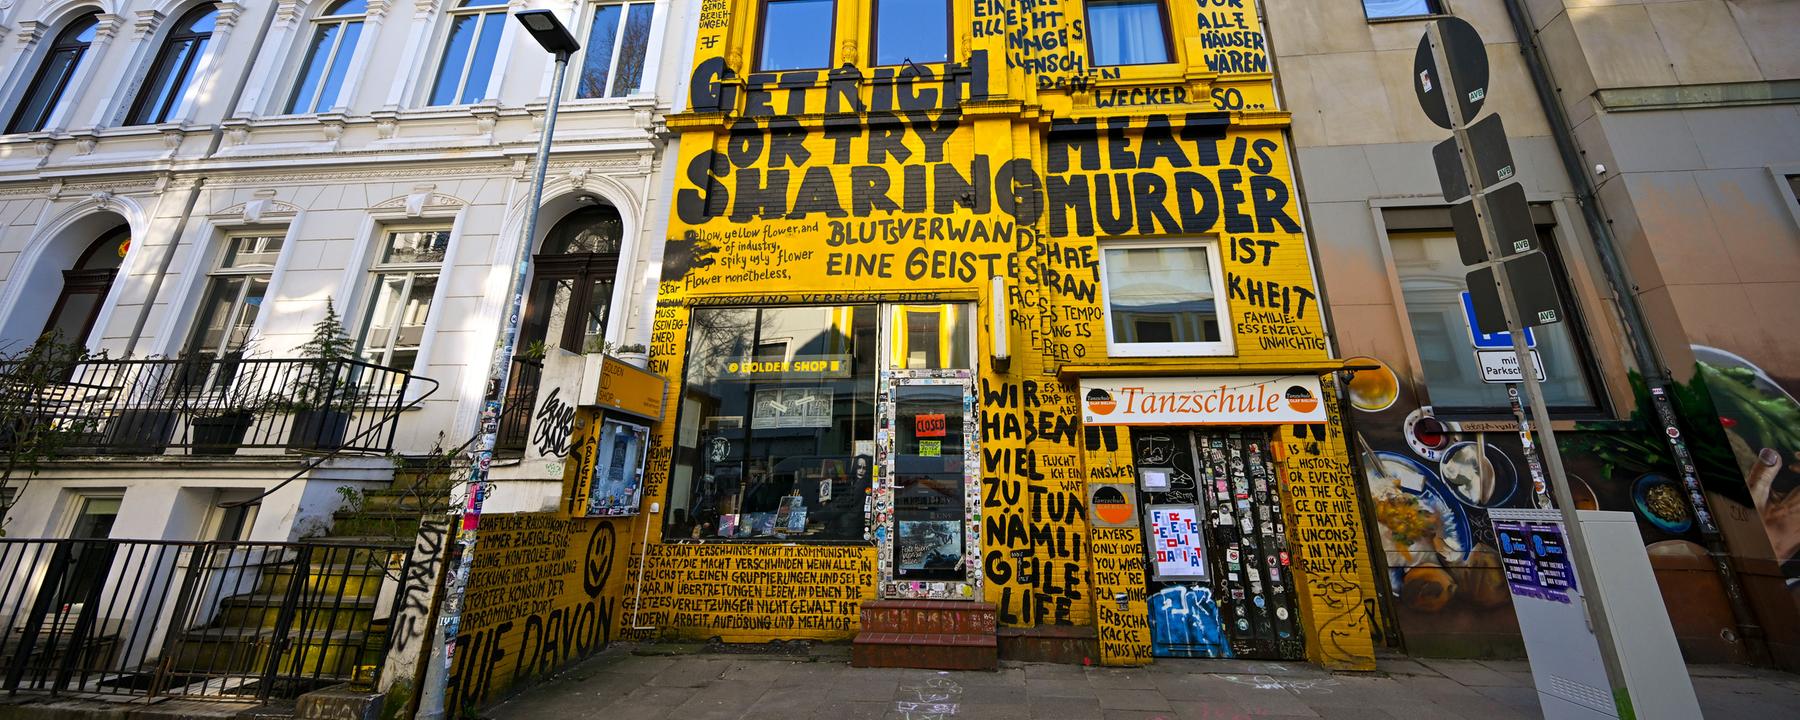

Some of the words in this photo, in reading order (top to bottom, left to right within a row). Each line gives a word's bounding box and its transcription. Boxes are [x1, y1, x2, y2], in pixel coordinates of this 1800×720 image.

[702, 2, 726, 12] GENDE
[1197, 11, 1249, 30] ALLE
[1200, 30, 1265, 50] HÄUSER
[1204, 49, 1267, 73] WÄREN
[690, 56, 818, 117] GET
[825, 49, 990, 113] RICH
[1095, 86, 1187, 108] WECKER
[1470, 90, 1484, 101] AVB
[727, 112, 812, 168] OR
[824, 110, 962, 165] TRY
[1046, 111, 1231, 174] MEAT
[1230, 136, 1278, 175] IS
[1499, 167, 1512, 178] AVB
[677, 150, 1044, 227] SHARING
[1046, 168, 1303, 238] MURDER
[725, 228, 761, 244] yellow
[725, 242, 735, 255] of
[1230, 237, 1280, 266] IST
[1515, 239, 1529, 250] AVB
[721, 252, 747, 268] spiky
[750, 252, 770, 267] ugly
[776, 249, 814, 266] flower
[826, 252, 896, 277] EINE
[685, 272, 722, 291] Flower
[725, 268, 792, 283] nonetheless,
[659, 283, 681, 296] Star
[655, 309, 676, 318] MUSS
[1244, 312, 1296, 326] FAMILIE:
[1540, 311, 1555, 321] AVB
[1075, 323, 1092, 337] IS
[1238, 323, 1313, 336] ESSENZIELL
[649, 343, 677, 357] BULLE
[1258, 334, 1326, 350] UNWICHTIG
[741, 361, 790, 373] GOLDEN
[793, 360, 828, 372] SHOP
[1501, 356, 1518, 365] mit
[981, 377, 1041, 408] WIR
[1121, 384, 1280, 414] Tanzschule
[917, 418, 945, 432] CLOSED
[981, 410, 1078, 447] HABEN
[983, 448, 1045, 480] VIEL
[1042, 455, 1077, 467] FLUCHT
[1050, 468, 1064, 479] ICH
[1090, 465, 1134, 479] ANSWER
[1289, 471, 1305, 482] OR
[982, 477, 1021, 507] ZU
[1292, 485, 1307, 497] ON
[1310, 485, 1332, 498] THE
[1314, 500, 1329, 513] OF
[1307, 513, 1337, 527] THAT
[483, 532, 512, 548] IMMER
[1092, 528, 1134, 541] PLAYERS
[505, 547, 551, 564] KONTROLLE
[551, 549, 566, 560] UND
[646, 544, 663, 556] DER
[666, 545, 692, 557] STAAT
[694, 545, 758, 557] VERSCHWINDET
[759, 546, 782, 557] NICHT
[784, 546, 793, 557] IM
[1093, 543, 1118, 554] ONLY
[1121, 543, 1143, 555] LOVE
[701, 557, 731, 569] MACHT
[736, 557, 803, 570] VERSCHWINDEN
[806, 558, 831, 570] WENN
[861, 560, 871, 572] IN
[1095, 557, 1115, 569] YOU
[1119, 558, 1145, 572] WHEN
[687, 569, 728, 581] KLEINEN
[820, 572, 839, 584] UND
[840, 572, 855, 585] SEI
[860, 574, 872, 586] ES
[508, 580, 546, 600] KONSUM
[547, 578, 565, 597] DER
[678, 579, 762, 598] ÜBERTRETUNGEN
[809, 586, 841, 599] DENEN
[846, 585, 862, 599] DIE
[757, 599, 788, 613] NICHT
[790, 599, 836, 614] GEWALT
[840, 601, 858, 615] IST
[1001, 586, 1074, 627] LIFE
[713, 614, 772, 630] AUFLÖSUNG
[774, 616, 795, 629] UND
[513, 596, 615, 681] DAVON
[1101, 626, 1141, 643] KACKE
[1104, 641, 1130, 658] MUSS
[1131, 644, 1152, 660] WEG
